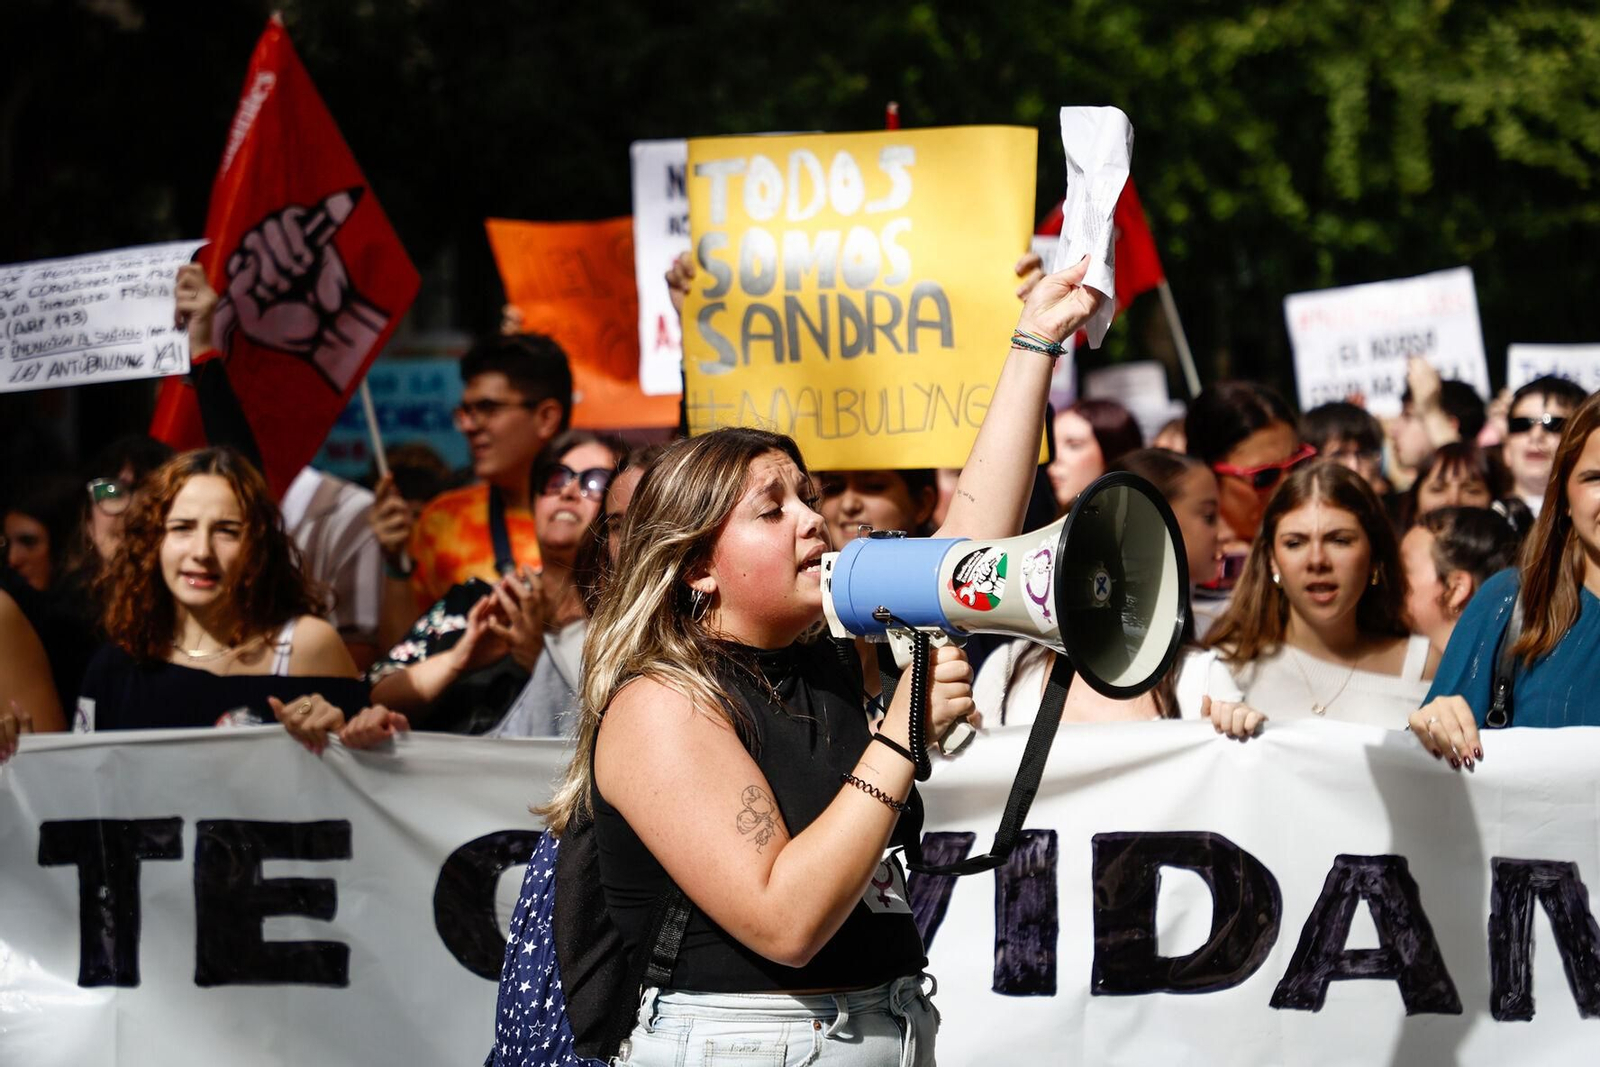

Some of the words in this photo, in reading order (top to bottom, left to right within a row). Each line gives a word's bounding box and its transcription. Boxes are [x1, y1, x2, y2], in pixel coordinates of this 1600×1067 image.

[694, 144, 916, 225] TODOS
[696, 218, 912, 299] SOMOS
[697, 281, 955, 376] SANDRA
[37, 817, 352, 987] TE
